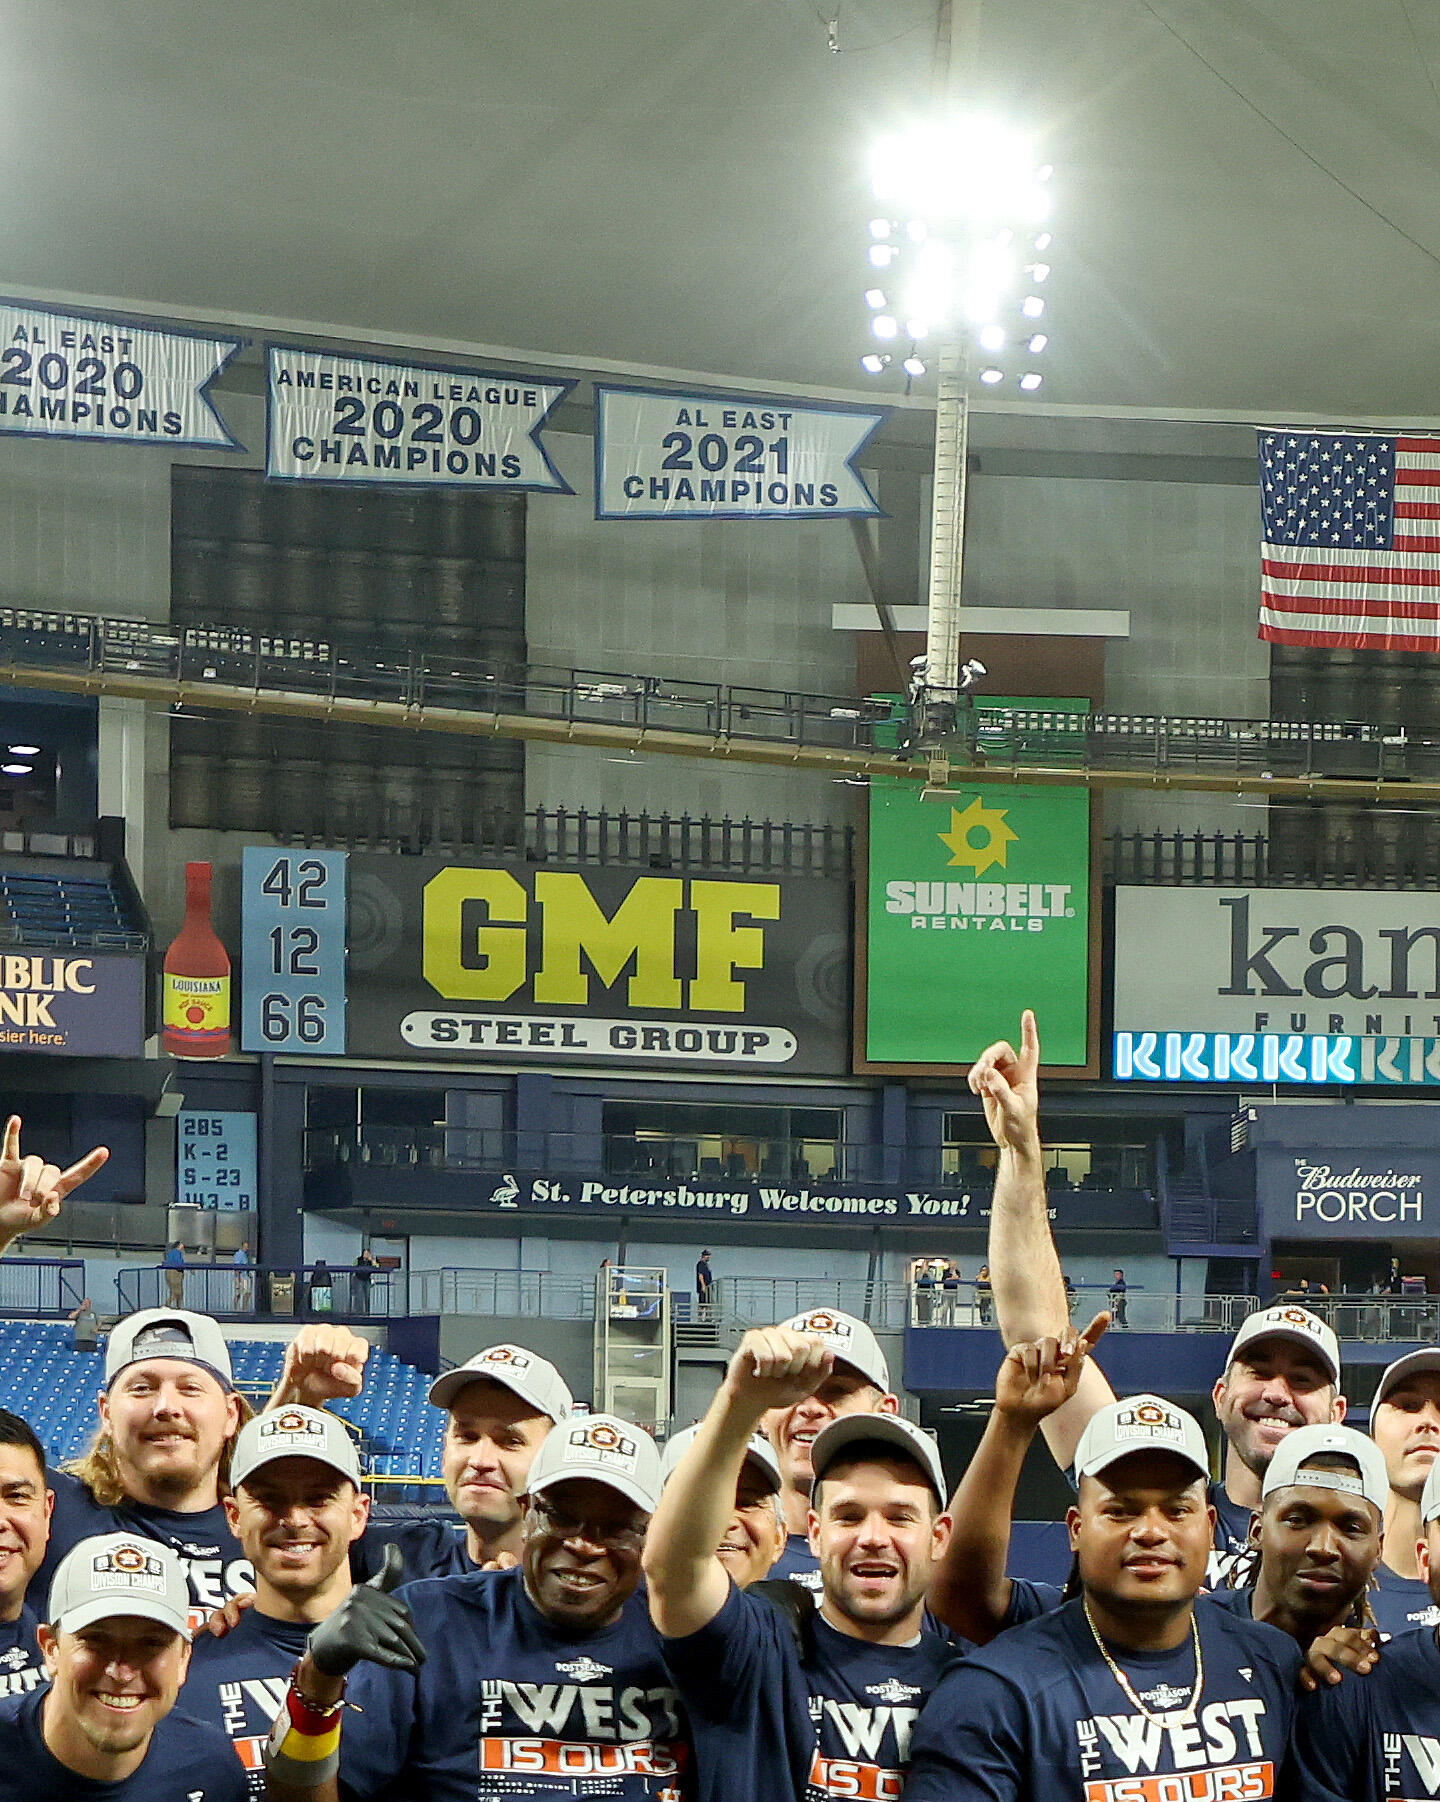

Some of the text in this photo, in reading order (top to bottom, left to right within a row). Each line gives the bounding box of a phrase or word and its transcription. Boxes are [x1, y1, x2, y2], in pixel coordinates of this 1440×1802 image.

[13, 325, 132, 354] AL EAST
[0, 348, 143, 399] 2020
[278, 370, 536, 406] AMERICAN LEAGUE
[333, 396, 481, 445] 2020
[676, 409, 792, 430] AL EAST
[293, 436, 521, 478] CHAMPIONS
[662, 432, 788, 474] 2021
[624, 476, 838, 506] CHAMPIONS
[261, 859, 328, 908] 42
[885, 881, 1070, 918] SUNBELT
[422, 866, 780, 1012] GMF
[911, 916, 1043, 932] RENTALS
[271, 928, 319, 976] 12
[261, 996, 325, 1044] 66
[430, 1019, 769, 1056] STEEL GROUP
[185, 1119, 222, 1136] 205
[1297, 1166, 1421, 1190] Budweiser
[531, 1180, 570, 1203] St.
[580, 1183, 749, 1215] Petersburg
[759, 1188, 896, 1215] Welcomes
[907, 1195, 969, 1216] You!
[1297, 1191, 1422, 1222] PORCH
[94, 1574, 164, 1591] DIVISION CHAMPS
[1383, 1733, 1402, 1792] THE
